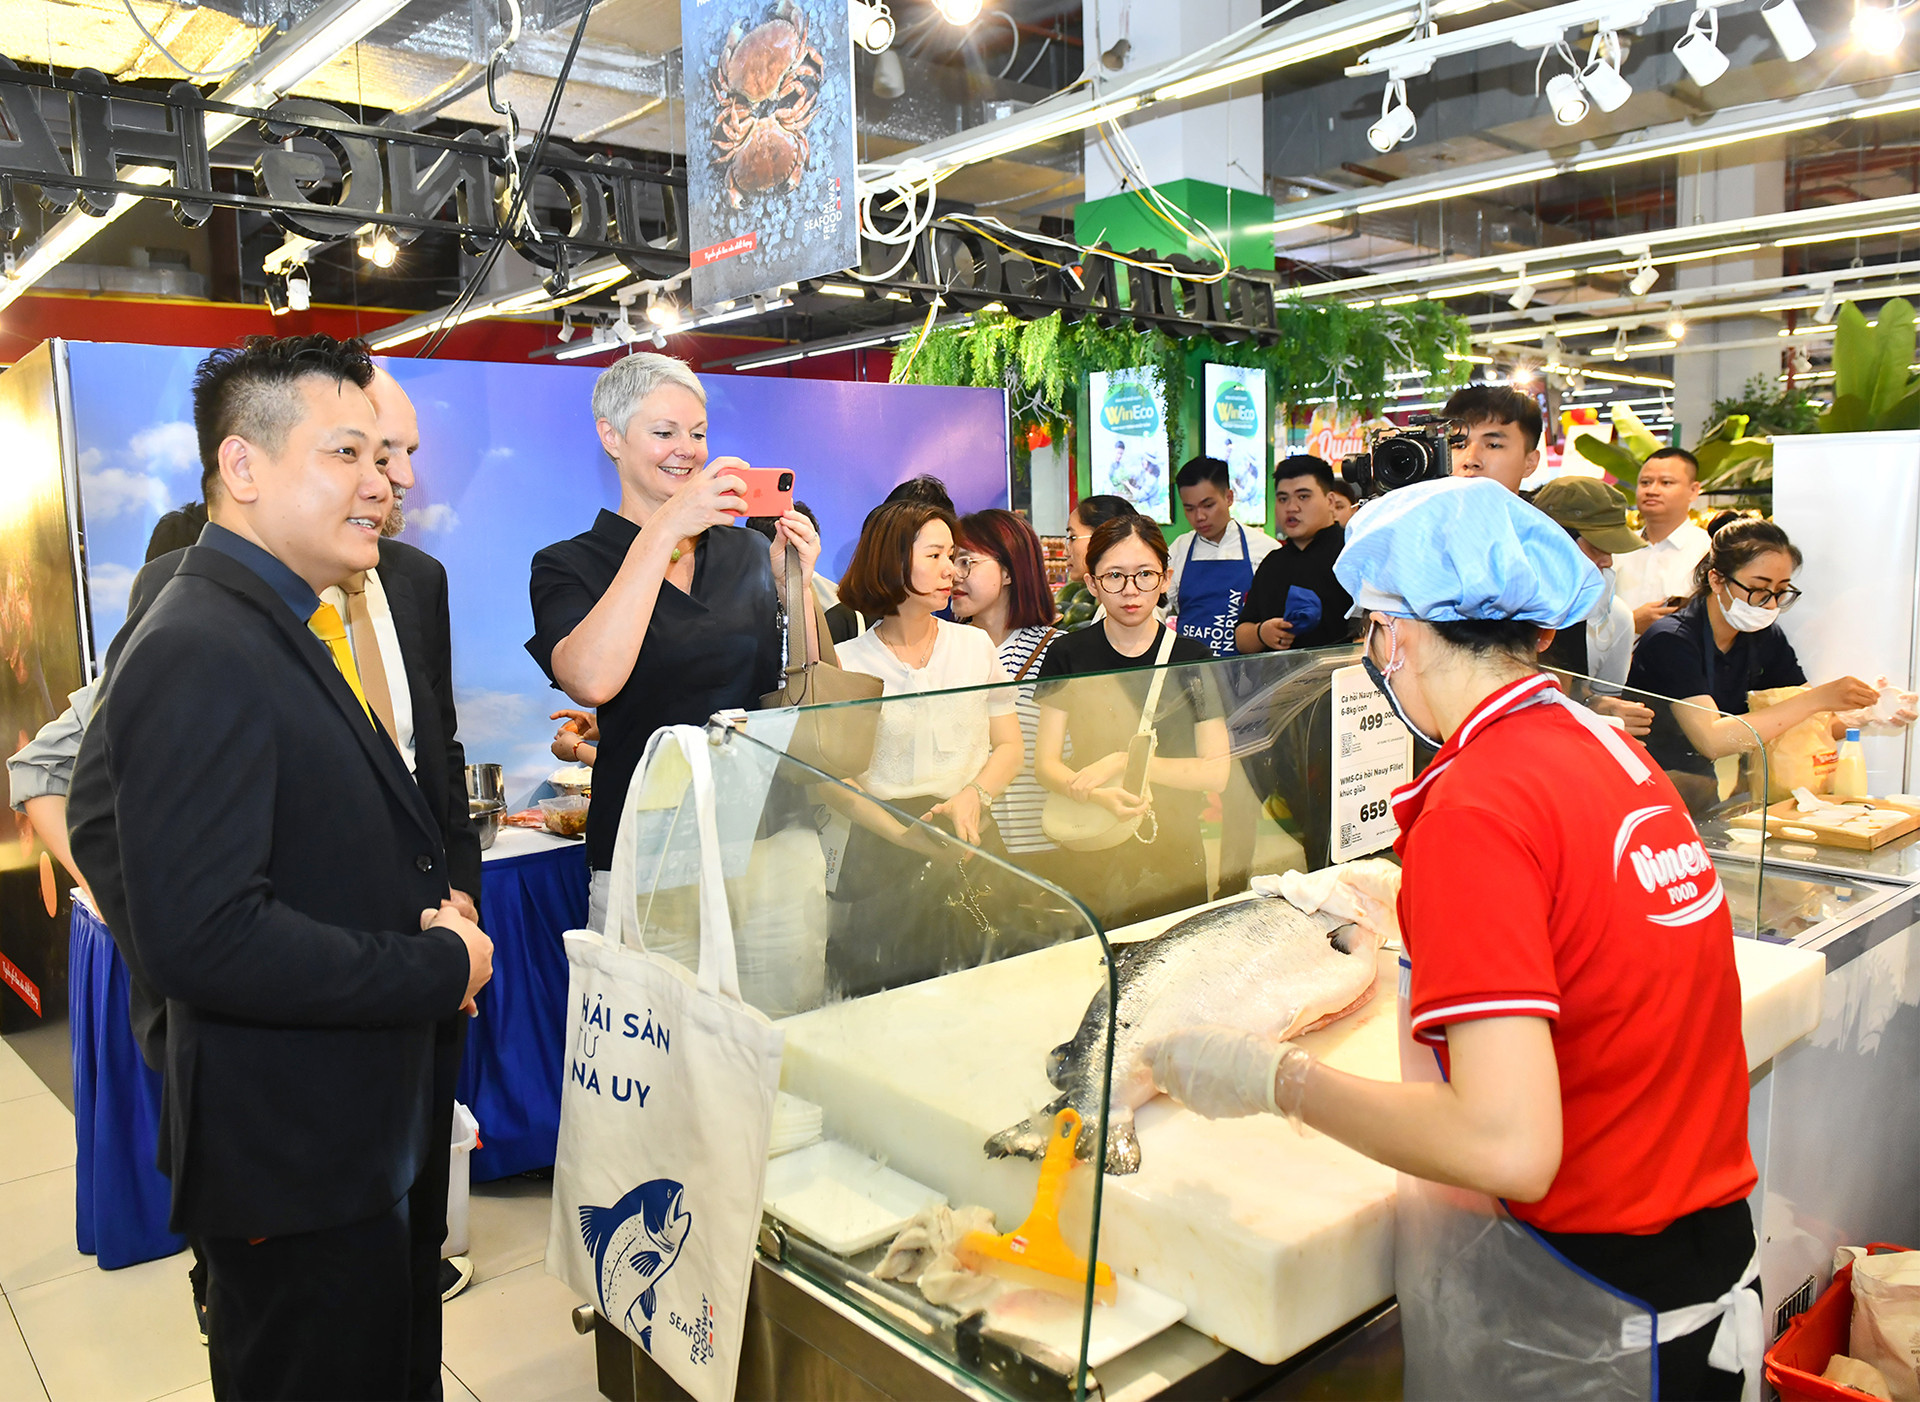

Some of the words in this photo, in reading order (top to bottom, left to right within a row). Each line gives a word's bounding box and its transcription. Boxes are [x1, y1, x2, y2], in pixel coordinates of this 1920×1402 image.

[804, 211, 842, 232] SEAFOOD
[1104, 404, 1154, 426] WinEco
[1216, 402, 1255, 422] WinEco
[1222, 589, 1242, 652] NORWAY
[1374, 767, 1389, 777] Nauy
[1390, 763, 1404, 772] Fillet
[1666, 881, 1699, 905] FOOD
[581, 992, 612, 1033] HẢI
[622, 1008, 670, 1056] SẢN
[571, 1058, 601, 1096] NA
[611, 1075, 651, 1109] UY
